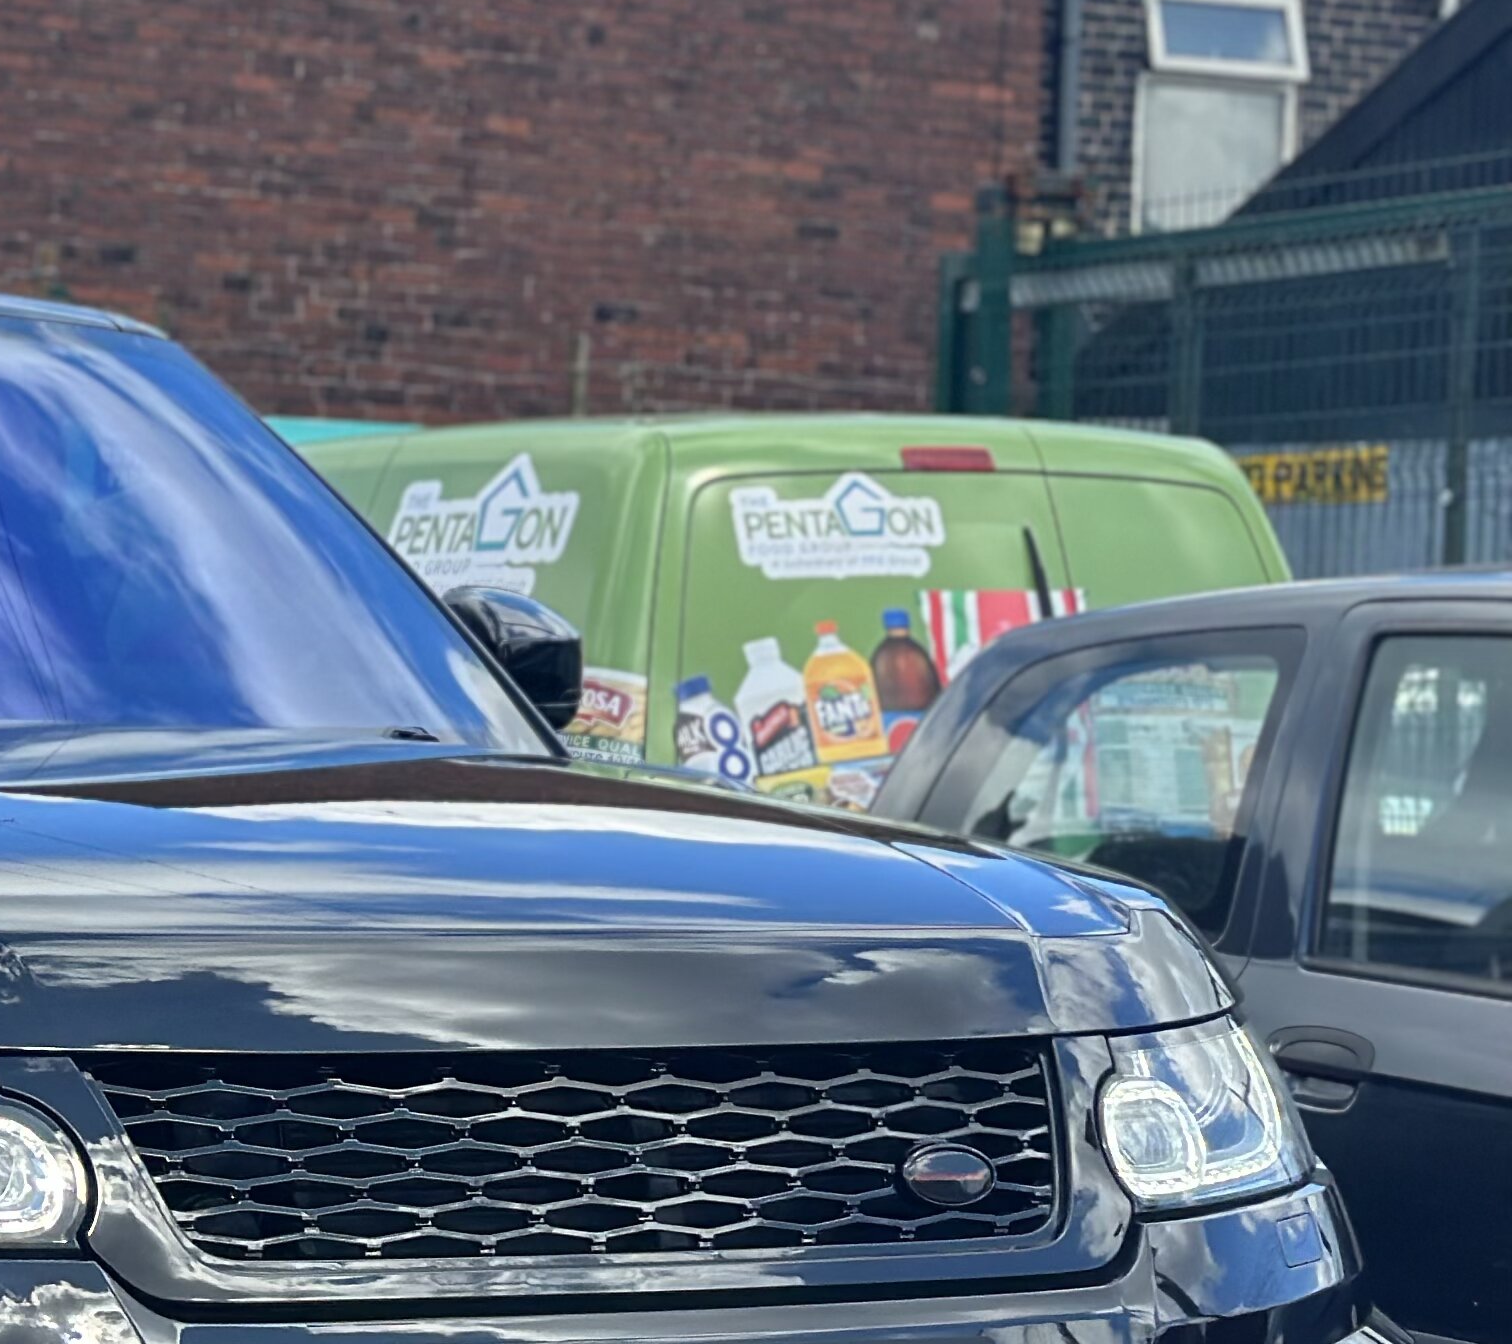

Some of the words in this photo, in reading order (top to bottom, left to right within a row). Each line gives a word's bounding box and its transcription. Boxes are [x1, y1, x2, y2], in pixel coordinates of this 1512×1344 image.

[394, 468, 568, 555] PENTAGON
[743, 479, 934, 540] PENTAGON
[581, 688, 621, 716] OSA
[562, 734, 591, 747] VICE
